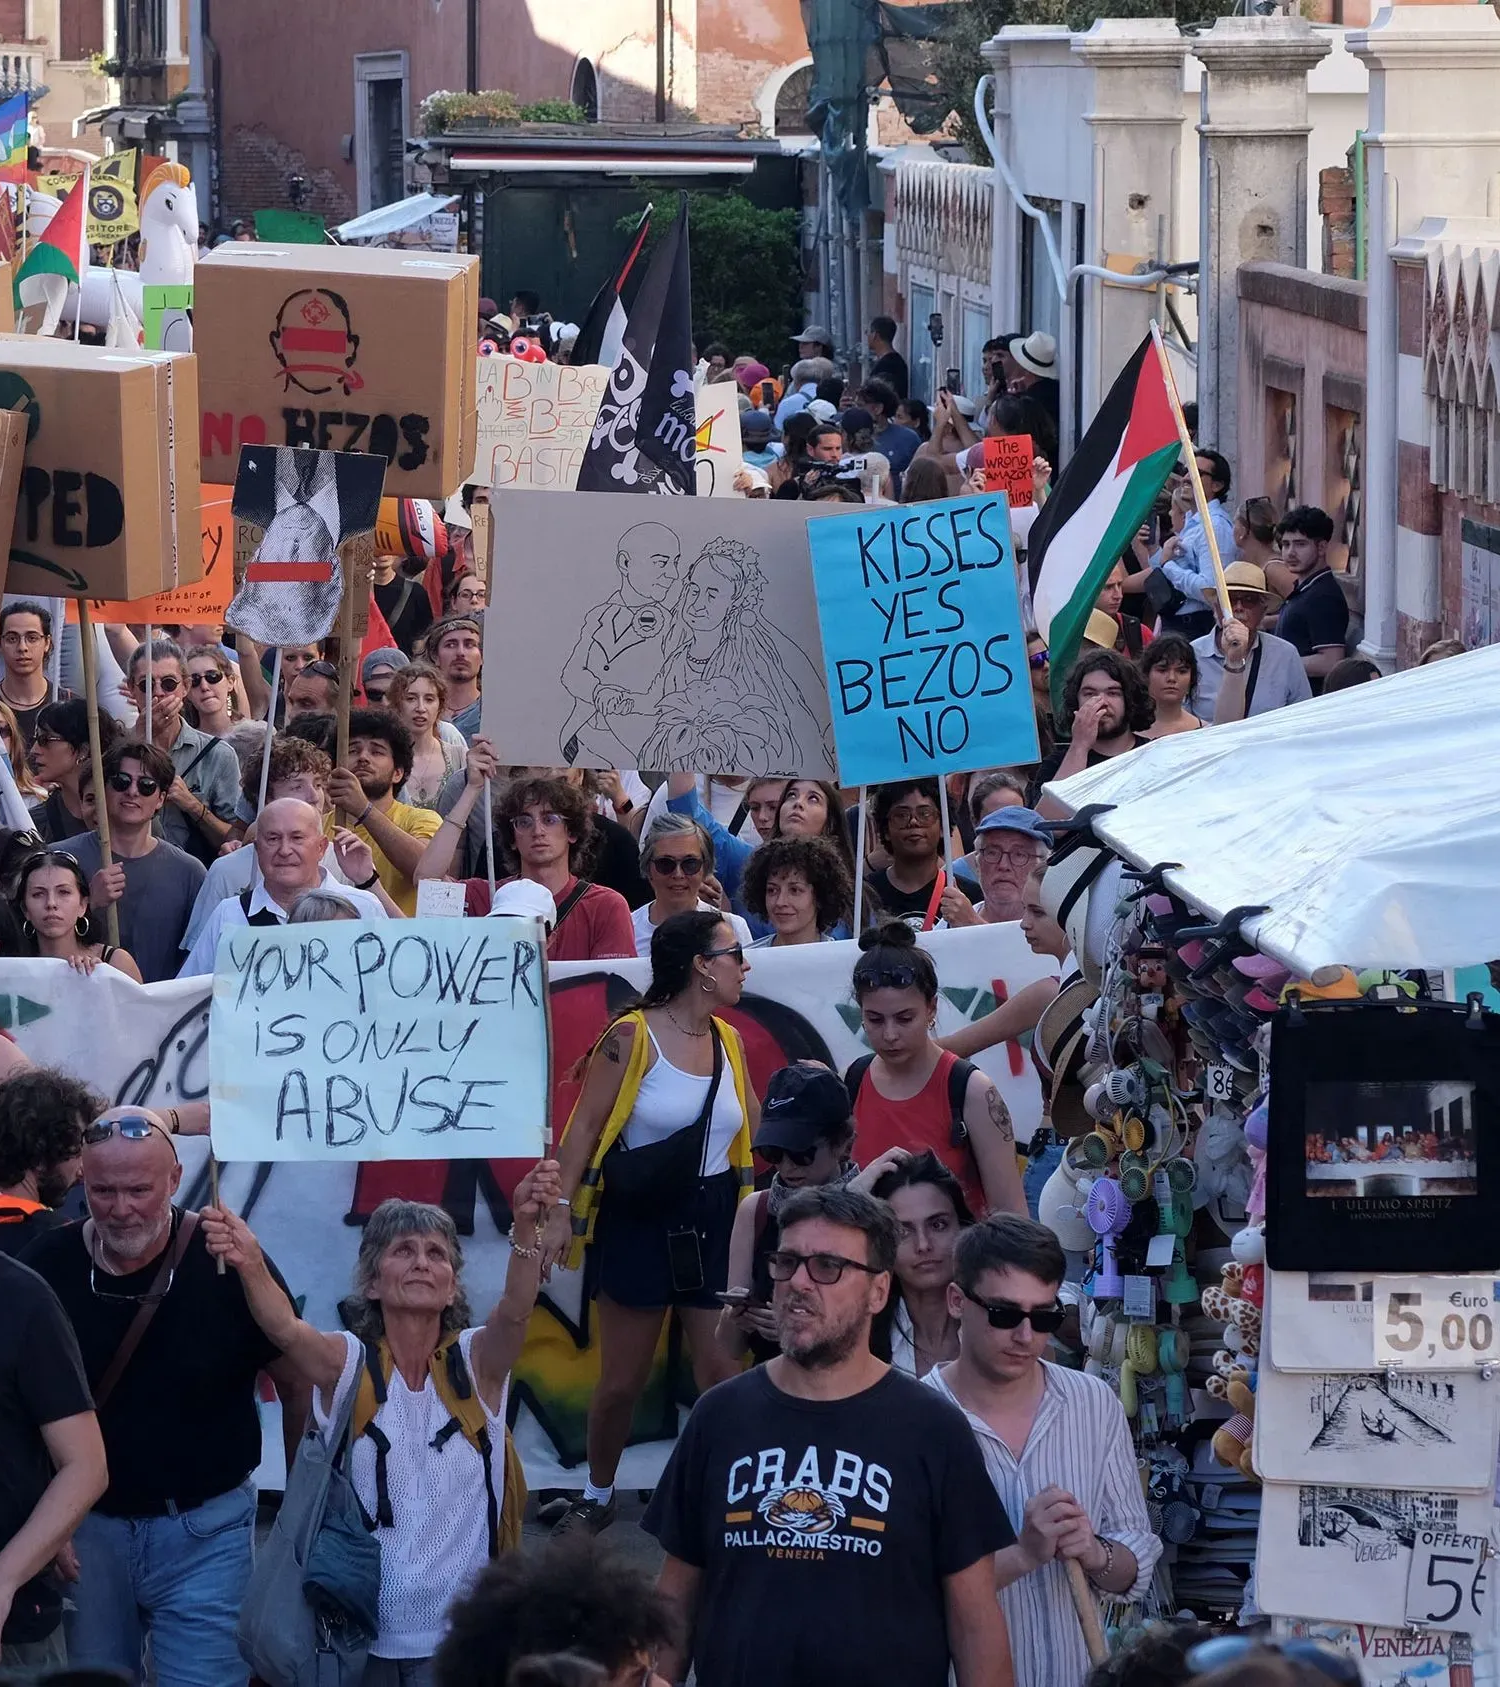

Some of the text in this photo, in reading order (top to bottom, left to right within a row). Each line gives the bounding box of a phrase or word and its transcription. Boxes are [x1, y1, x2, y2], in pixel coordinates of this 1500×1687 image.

[478, 363, 498, 384] LA
[536, 366, 553, 384] IN
[529, 398, 598, 435] BEZO
[202, 411, 266, 457] NO
[281, 406, 430, 471] BEZOS
[993, 438, 1020, 454] The
[490, 444, 584, 485] BASTA
[857, 501, 1004, 588] KISSES
[155, 591, 212, 602] HAVE A BIT OF
[196, 605, 222, 614] SHAME
[871, 580, 965, 645] YES
[835, 634, 1013, 716] BEZOS
[897, 705, 970, 764] NO
[230, 931, 539, 1015] YOUR POWER
[322, 1016, 482, 1079] ONLY
[275, 1066, 509, 1148] ABUSE
[1345, 1198, 1401, 1211] ULTIMO
[1406, 1198, 1452, 1210] SPRITZ
[1345, 1302, 1374, 1314] ULTI
[1384, 1292, 1494, 1359] 5,00
[726, 1445, 893, 1513] CRABS
[724, 1529, 883, 1557] PALLACANESTRO
[765, 1547, 826, 1561] VENEZIA
[1354, 1542, 1399, 1563] VENEZIA
[1421, 1531, 1482, 1550] OFFERT
[1354, 1622, 1446, 1659] VENEZIA
